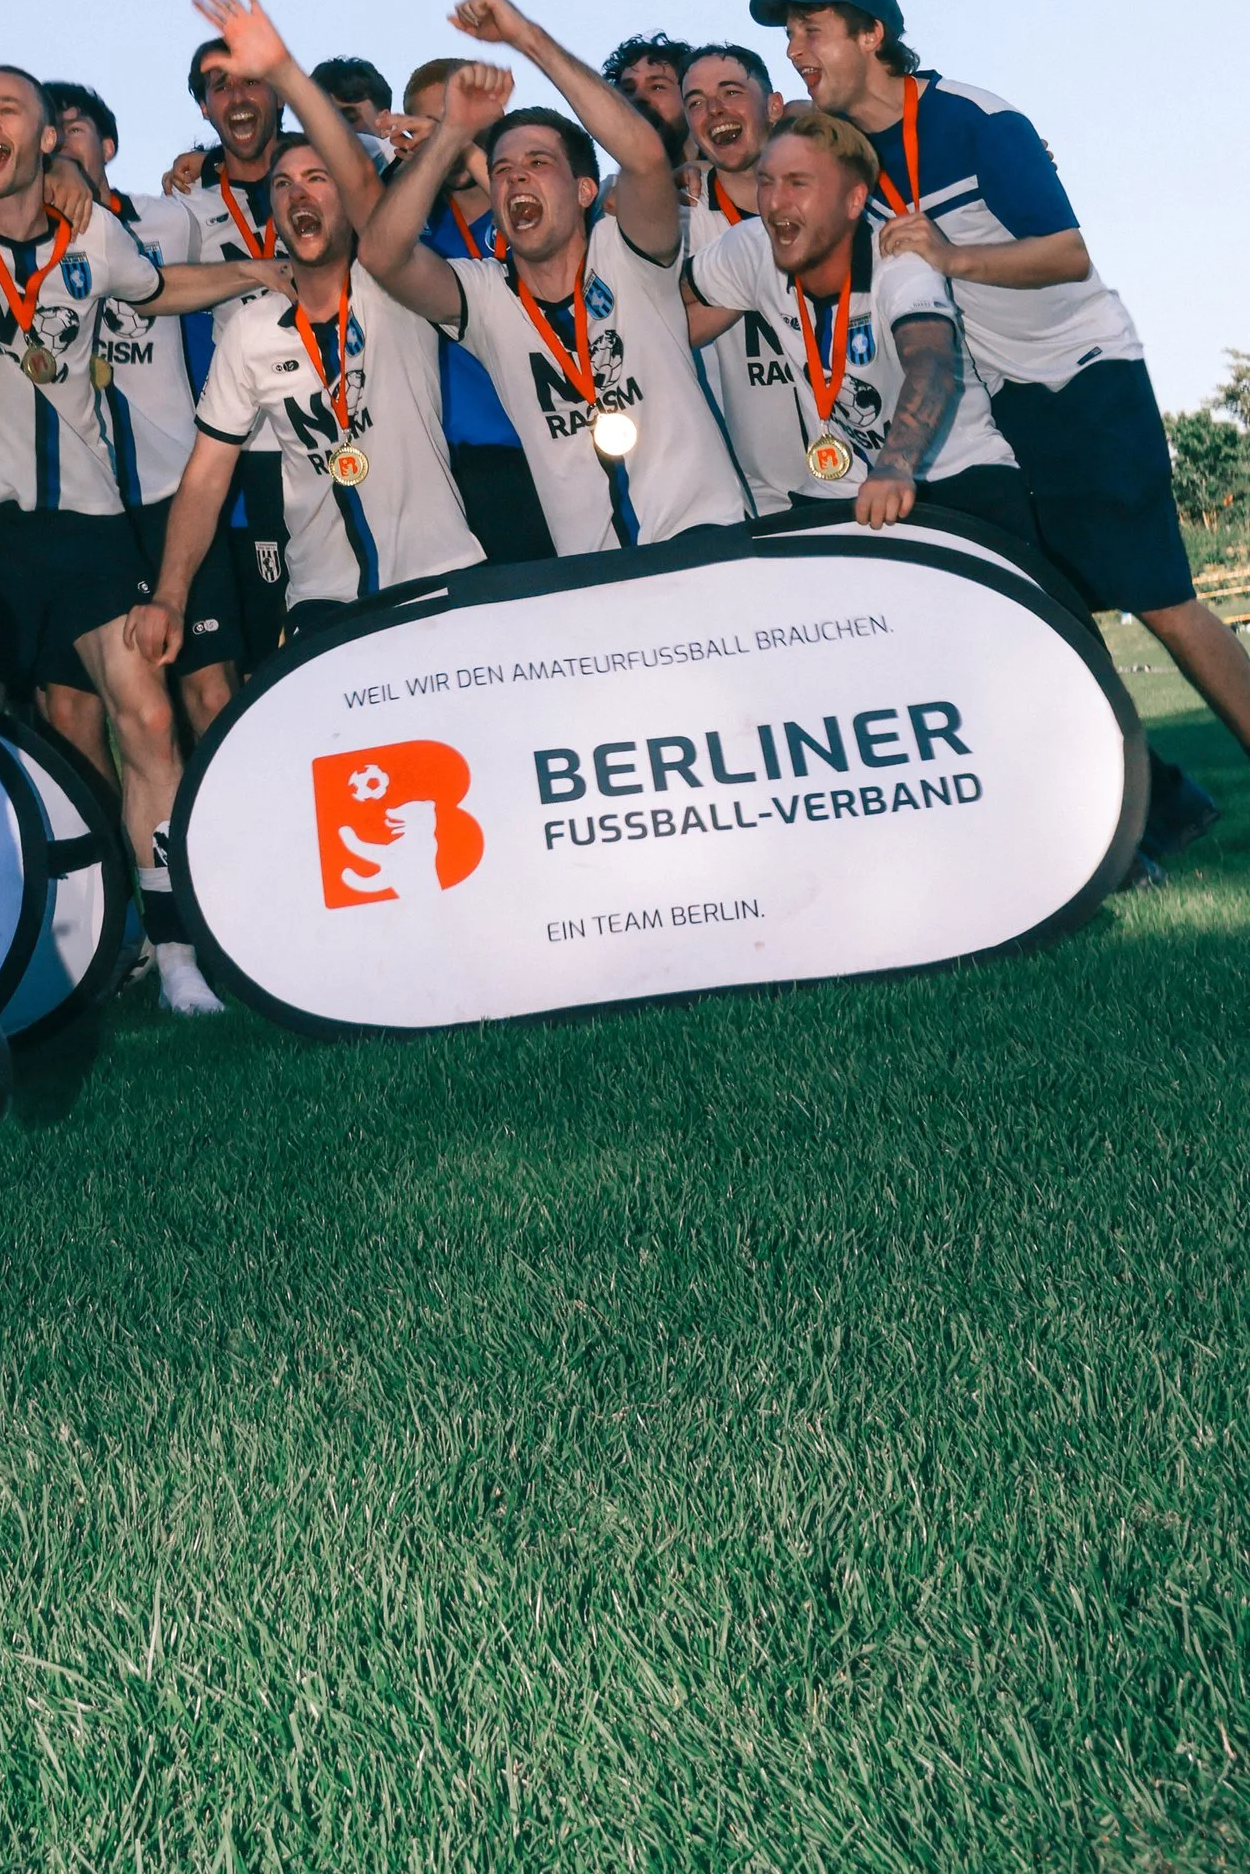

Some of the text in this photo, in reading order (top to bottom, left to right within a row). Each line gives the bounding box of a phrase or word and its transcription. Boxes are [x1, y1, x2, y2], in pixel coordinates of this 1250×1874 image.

[97, 340, 154, 364] CISM
[344, 615, 894, 709] WEIL WIR DEN AMATEURFUSSBALL BRAUCHEN.
[533, 701, 974, 804] BERLINER
[543, 772, 983, 850] FUSSBALL-VERBAND
[547, 899, 766, 942] EIN TEAM BERLIN.
